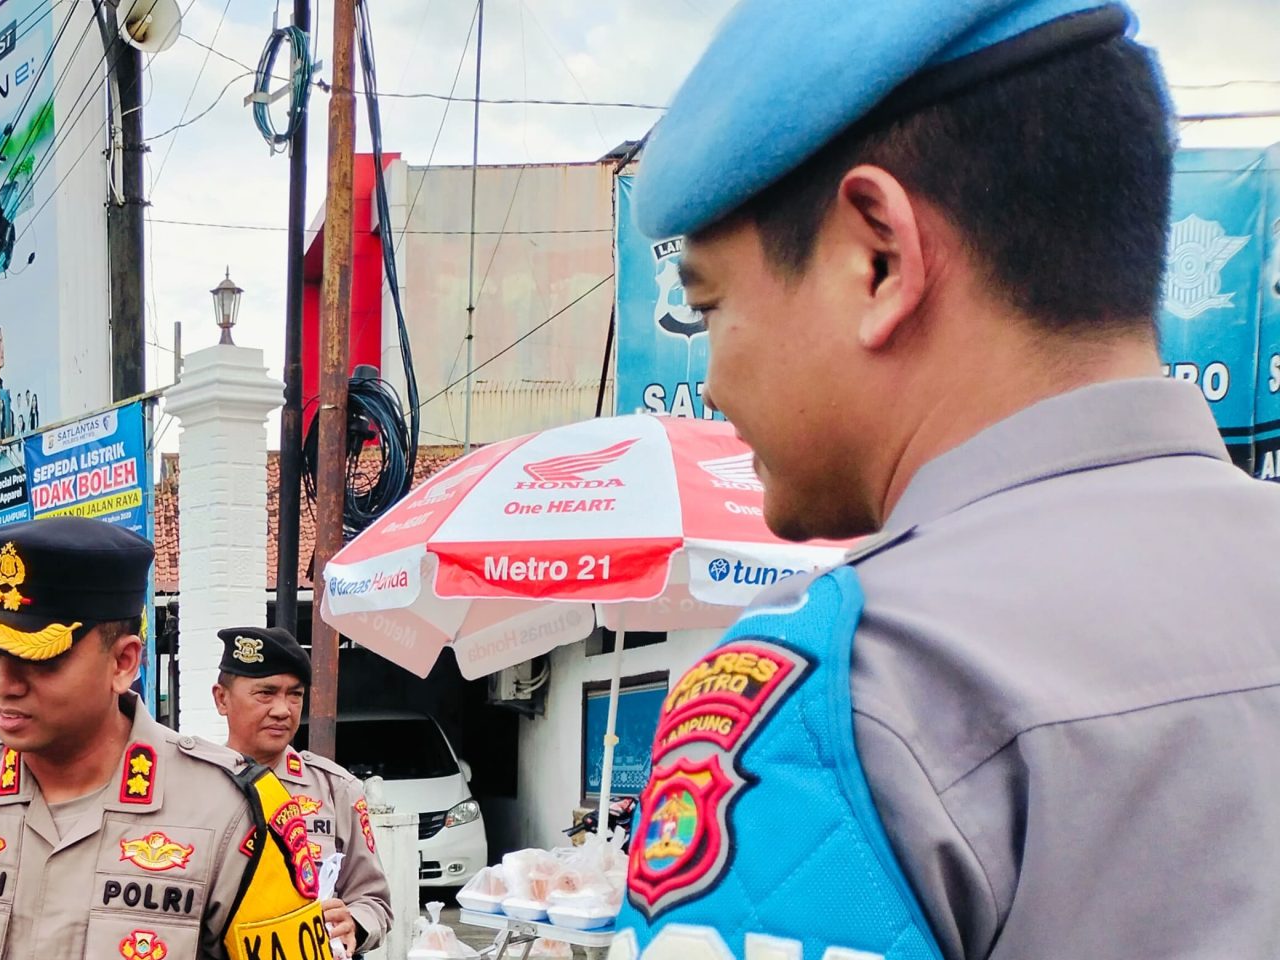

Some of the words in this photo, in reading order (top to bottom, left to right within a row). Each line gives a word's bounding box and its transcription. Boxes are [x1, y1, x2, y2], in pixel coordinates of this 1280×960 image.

[57, 420, 100, 442] SATLANTAS
[33, 457, 78, 483] SEPEDA
[80, 441, 126, 469] LISTRIK
[32, 476, 76, 511] IDAK
[77, 457, 137, 500] BOLEH
[514, 478, 626, 491] HONDA
[87, 499, 114, 516] JALAN
[116, 492, 139, 509] RAYA
[503, 500, 544, 516] One
[546, 497, 616, 514] HEART.
[484, 555, 569, 582] Metro
[577, 555, 611, 581] 21
[103, 880, 195, 914] POLRI
